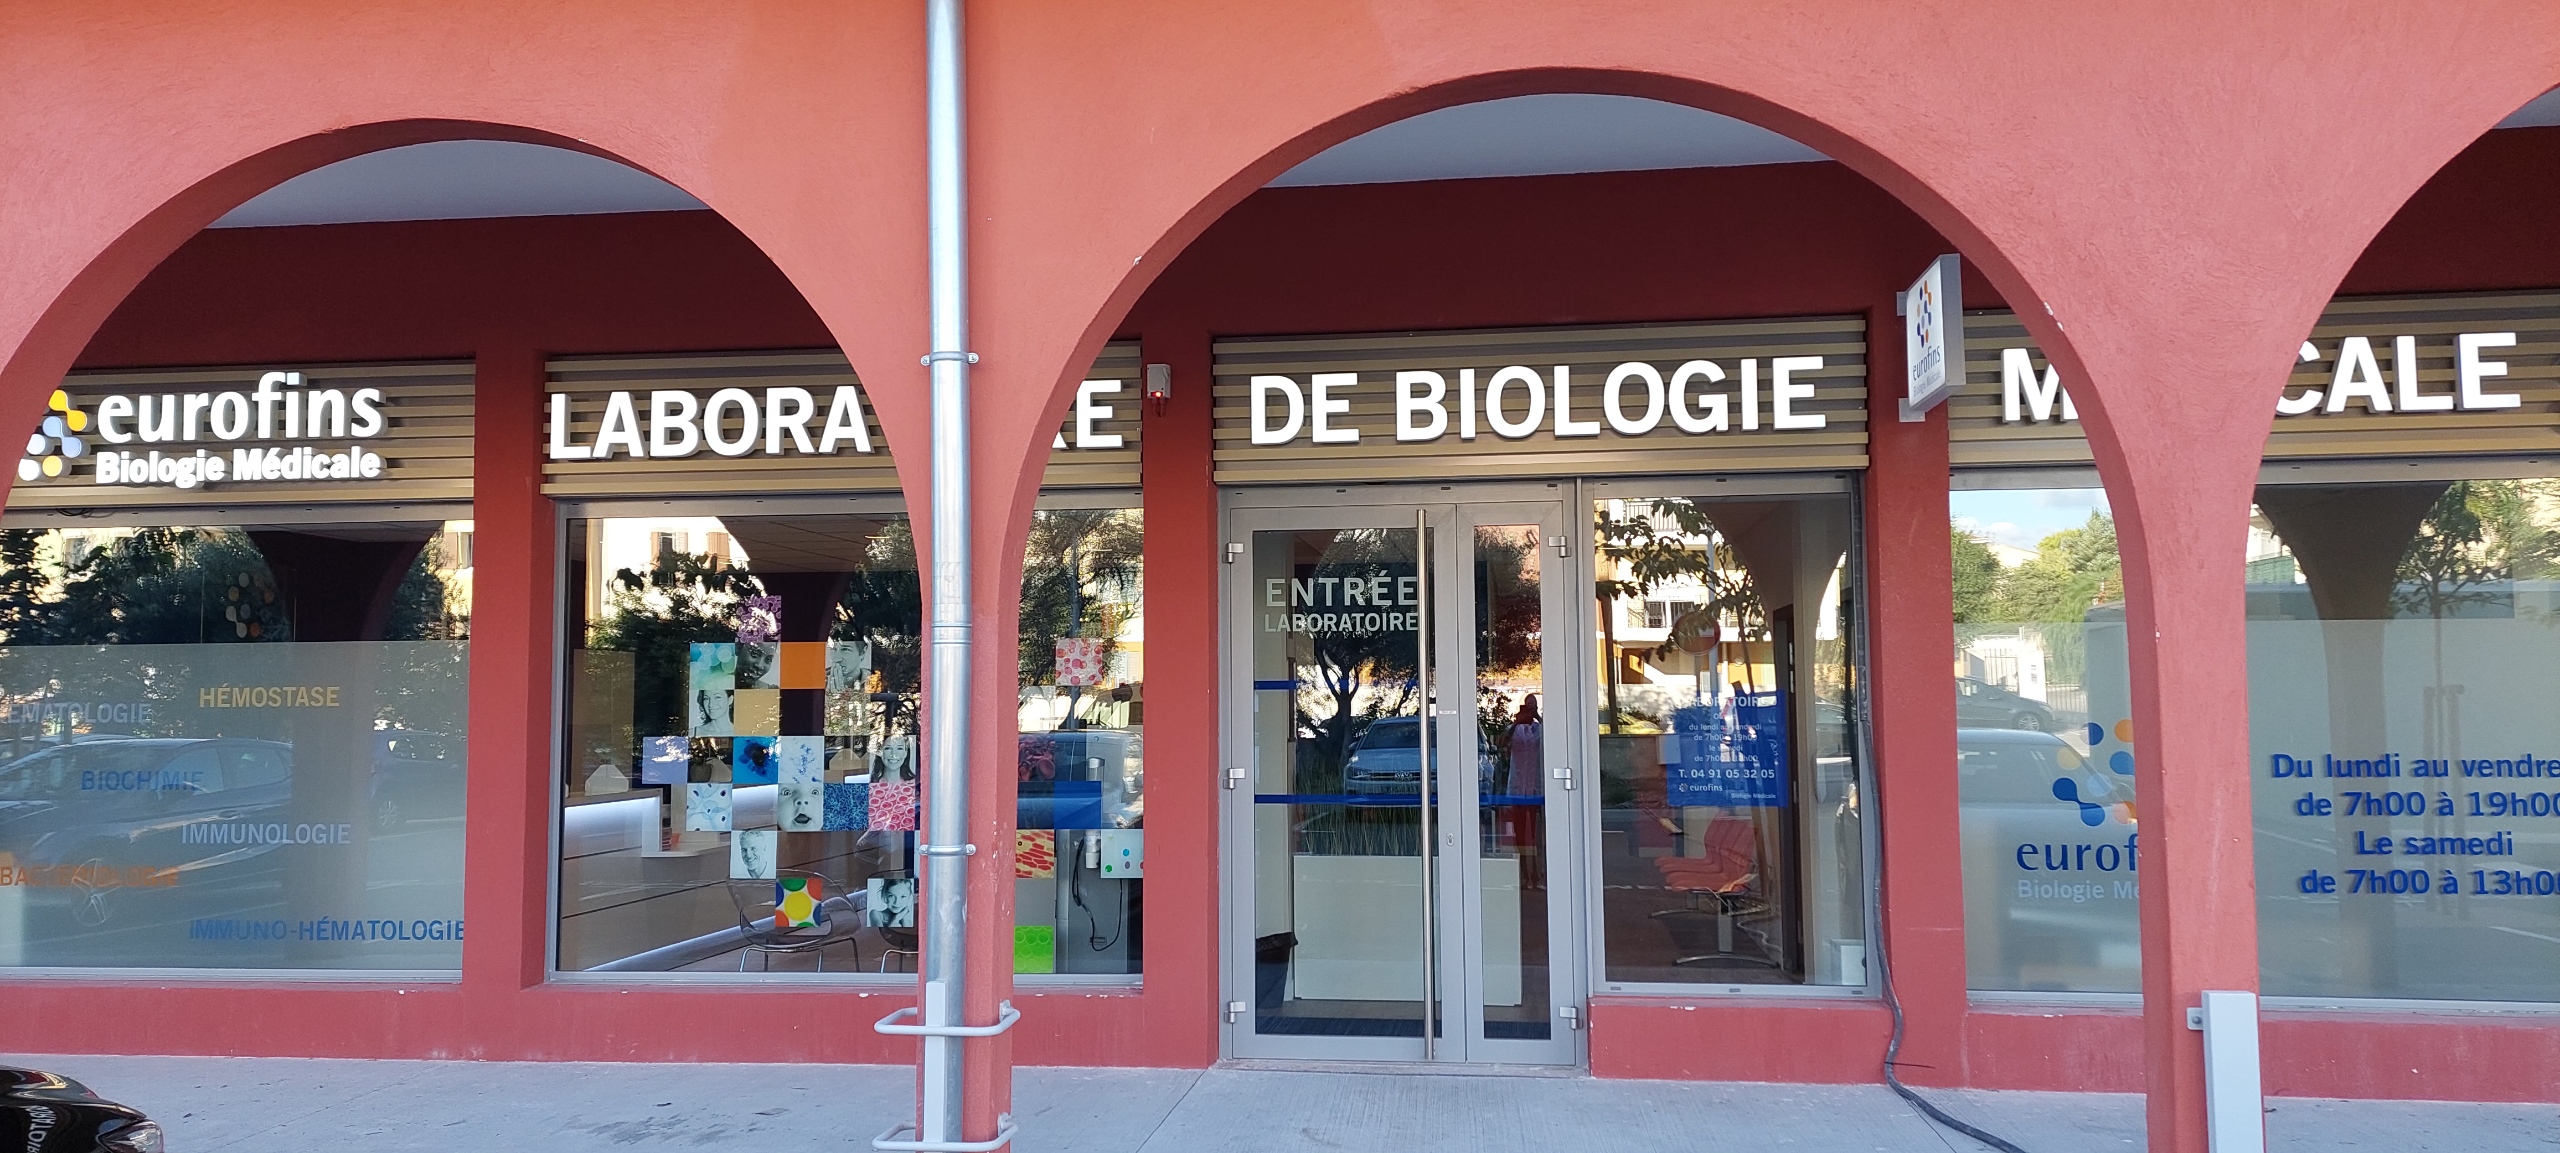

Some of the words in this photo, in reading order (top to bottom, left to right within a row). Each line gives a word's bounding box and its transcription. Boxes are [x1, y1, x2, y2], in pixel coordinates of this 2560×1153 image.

[1913, 345, 1940, 381] eurofins
[98, 371, 386, 443] eurofins
[1249, 372, 1360, 445] DE
[1395, 356, 1827, 439] BIOLOGIE
[96, 449, 231, 489] Biologie
[233, 446, 386, 481] Médicale
[1266, 570, 1418, 607] ENTRÉE
[1264, 613, 1418, 632] LABORATOIRE
[200, 683, 340, 708] HÉMOSTASE
[1693, 733, 1703, 741] de
[1679, 769, 1688, 778] T.
[1690, 769, 1705, 778] 04
[1708, 769, 1722, 778] 91
[1726, 769, 1740, 778] 05
[1743, 769, 1757, 778] 32
[1761, 769, 1775, 778] 05
[2271, 753, 2313, 778] Du
[2324, 753, 2401, 778] lundi
[2411, 758, 2449, 778] au
[81, 770, 204, 791] BIOCHIMIE
[1689, 783, 1723, 792] eurofins
[2295, 791, 2333, 817] de
[2341, 791, 2427, 817] 7h00
[2436, 791, 2455, 817] à
[182, 823, 351, 844] IMMUNOLOGIE
[2355, 830, 2394, 856] Le
[2402, 830, 2514, 856] samedi
[2016, 833, 2138, 872] eurof
[2018, 880, 2105, 903] Biologie
[2299, 869, 2337, 895] de
[2344, 869, 2430, 895] 7h00
[2440, 869, 2460, 895] à
[2471, 870, 2560, 896] 13h0
[189, 916, 464, 941] IMMUNO-HÉMATOLOGIE
